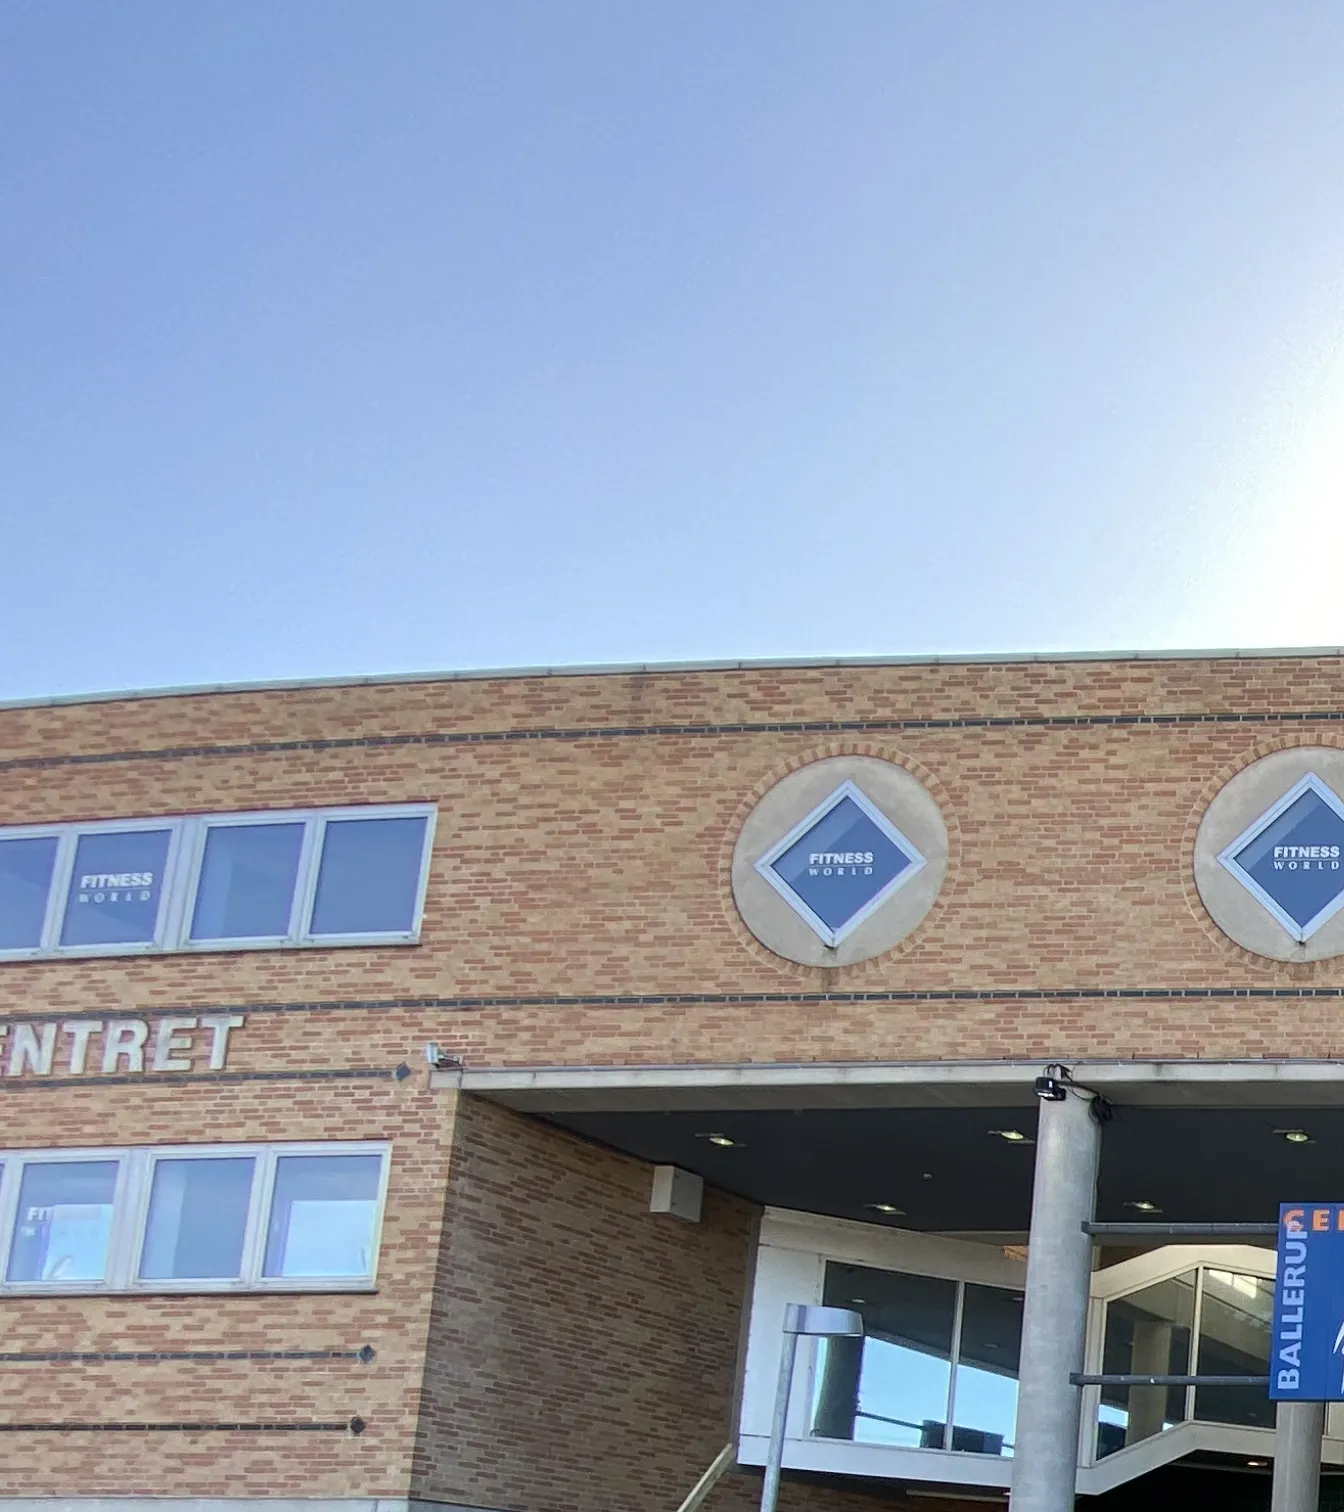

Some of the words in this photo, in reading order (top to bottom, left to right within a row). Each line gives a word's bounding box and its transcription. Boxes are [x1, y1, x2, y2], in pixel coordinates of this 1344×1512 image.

[809, 852, 874, 864] FITNESS
[1273, 845, 1340, 858] FITNESS
[809, 866, 873, 876] WORLD
[1273, 861, 1340, 871] WORLD
[80, 872, 153, 888] FITNESS
[0, 1015, 244, 1077] NTRET
[1277, 1220, 1309, 1390] BALLERUP
